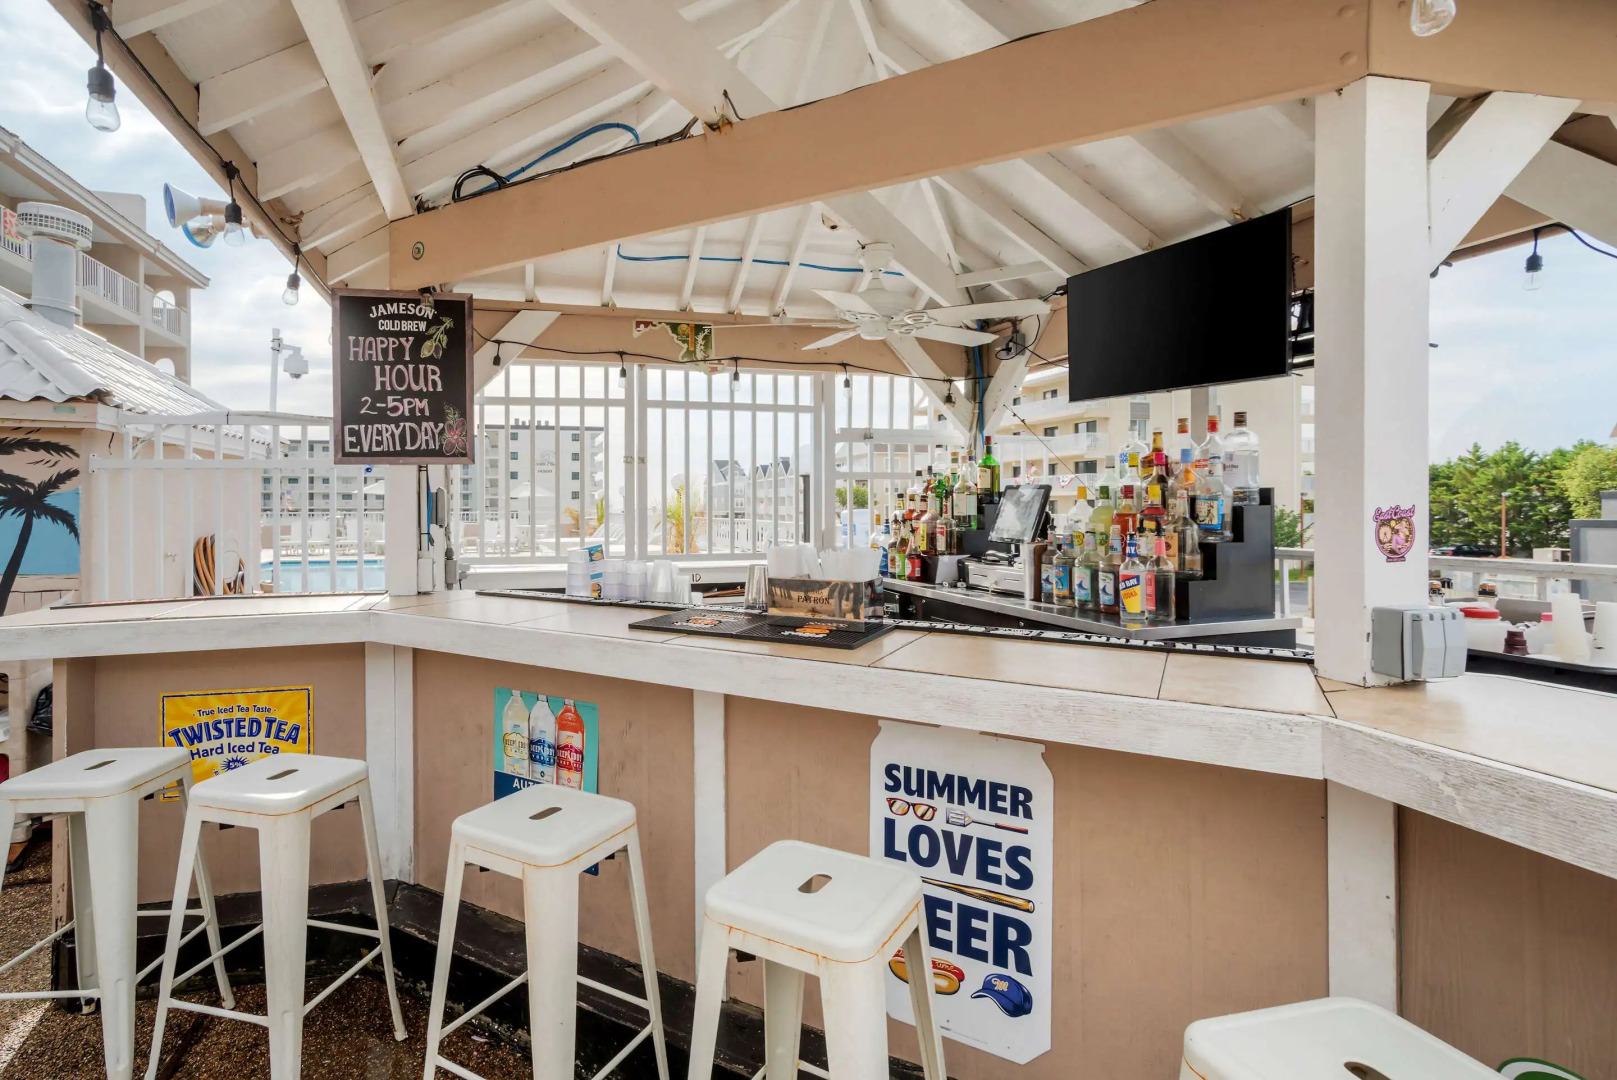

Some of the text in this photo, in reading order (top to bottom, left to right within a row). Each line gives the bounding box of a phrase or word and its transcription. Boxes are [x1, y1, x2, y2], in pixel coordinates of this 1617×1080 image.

[369, 302, 434, 320] JAMESON
[378, 319, 427, 332] COLD BREW
[348, 336, 415, 361] HAPPY
[374, 364, 443, 392] HOUR
[360, 396, 430, 417] 2-5PM
[692, 573, 702, 583] ID
[1125, 577, 1138, 588] BAY
[197, 704, 272, 717] True Iced Tea Taste
[167, 716, 301, 748] TWISTED TEA
[190, 741, 280, 761] Hard Iced Tea
[513, 778, 536, 790] AUT
[884, 763, 1034, 820] SUMMER
[884, 816, 1034, 891] LOVES
[923, 893, 1034, 977] EER
